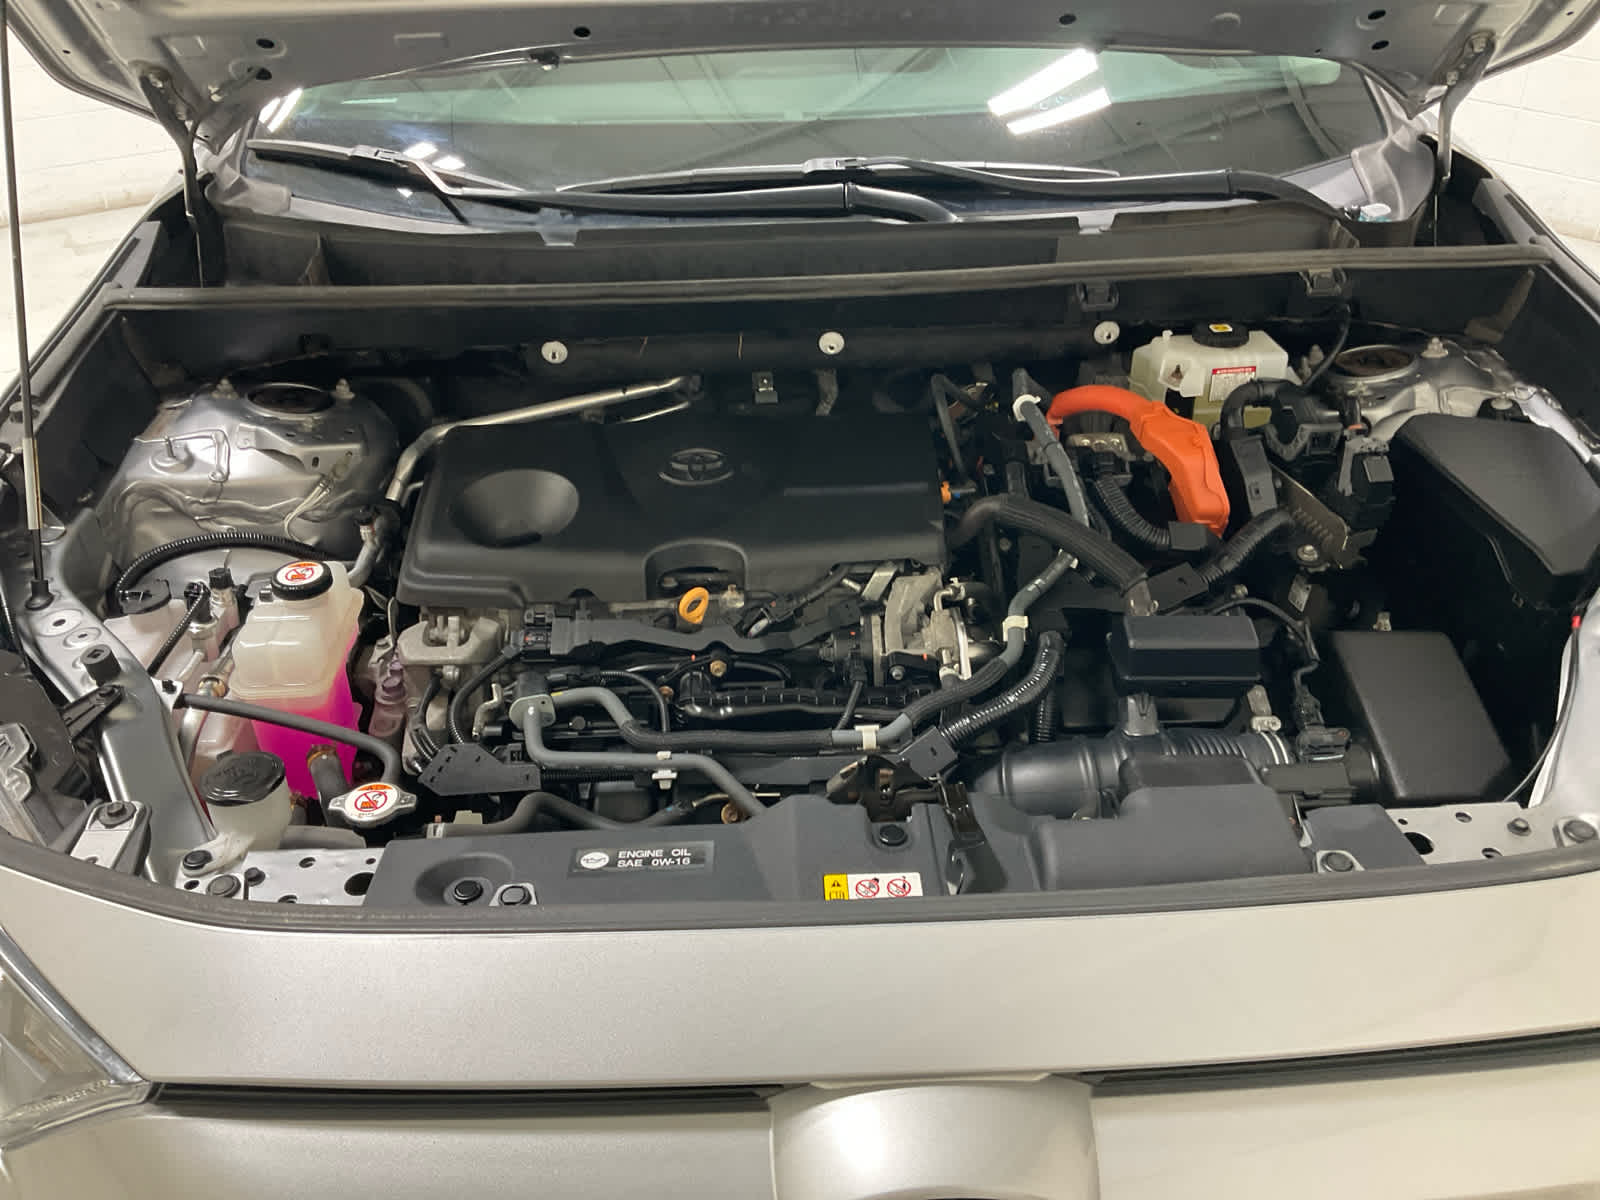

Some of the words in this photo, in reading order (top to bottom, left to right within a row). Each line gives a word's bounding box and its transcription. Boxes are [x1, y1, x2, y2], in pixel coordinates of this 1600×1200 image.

[618, 849, 663, 859] ENGINE
[671, 848, 692, 857] OIL
[617, 859, 643, 868] SAE
[651, 857, 691, 866] 0W-16
